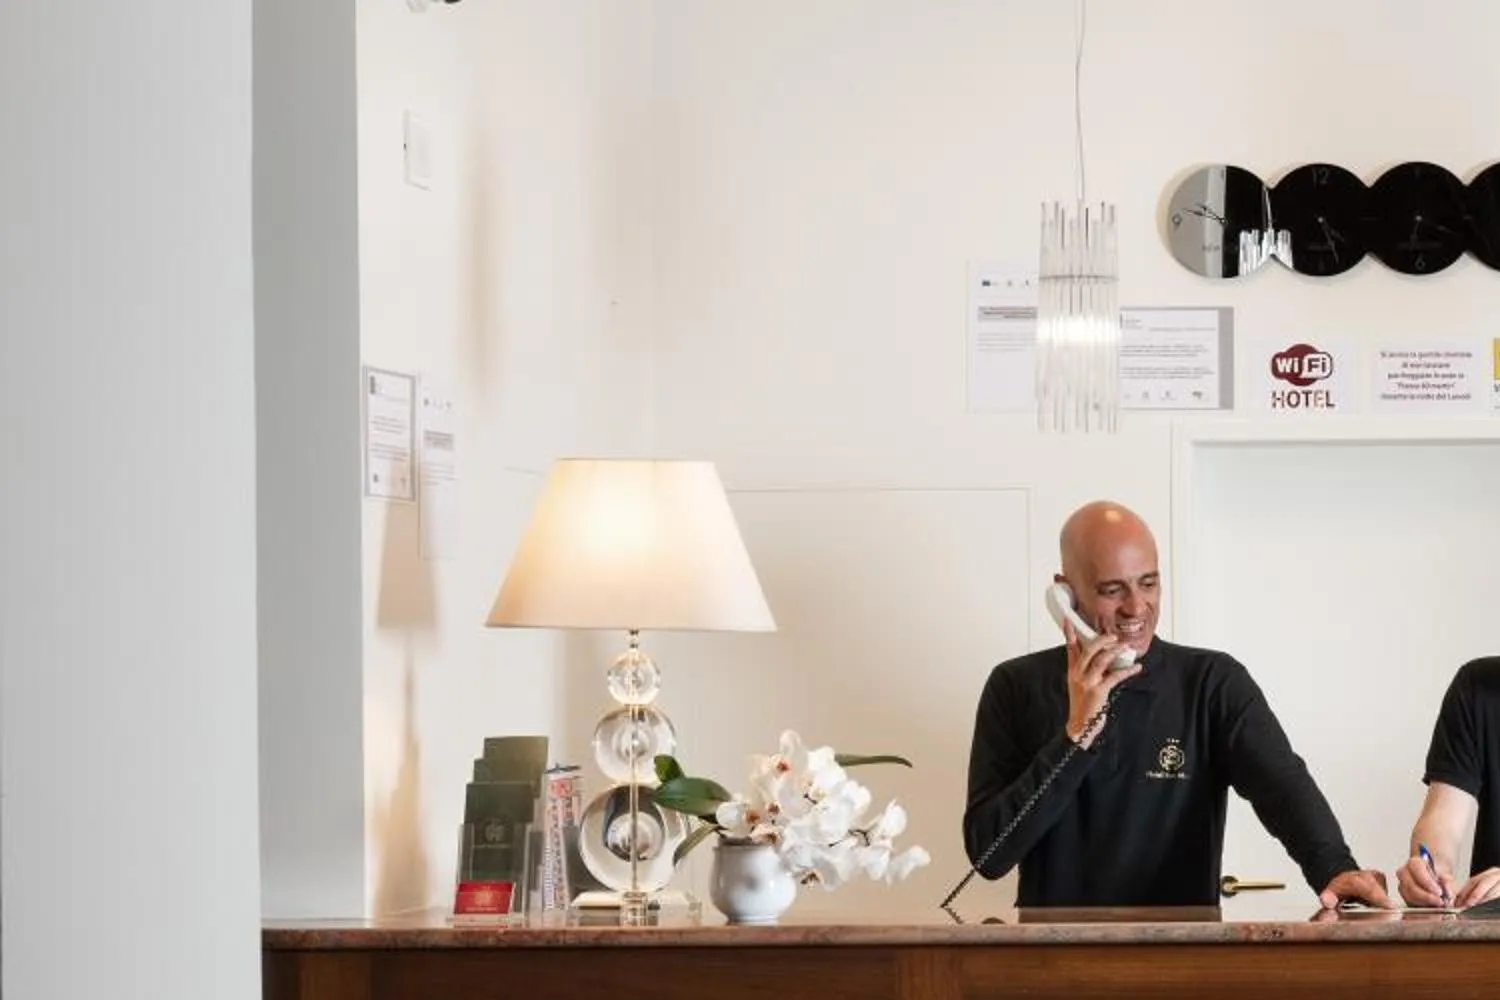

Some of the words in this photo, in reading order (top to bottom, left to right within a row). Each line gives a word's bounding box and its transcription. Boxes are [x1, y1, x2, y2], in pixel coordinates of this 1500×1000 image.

[1311, 168, 1329, 189] 12
[1414, 254, 1426, 271] 6
[1271, 390, 1336, 408] HOTEL
